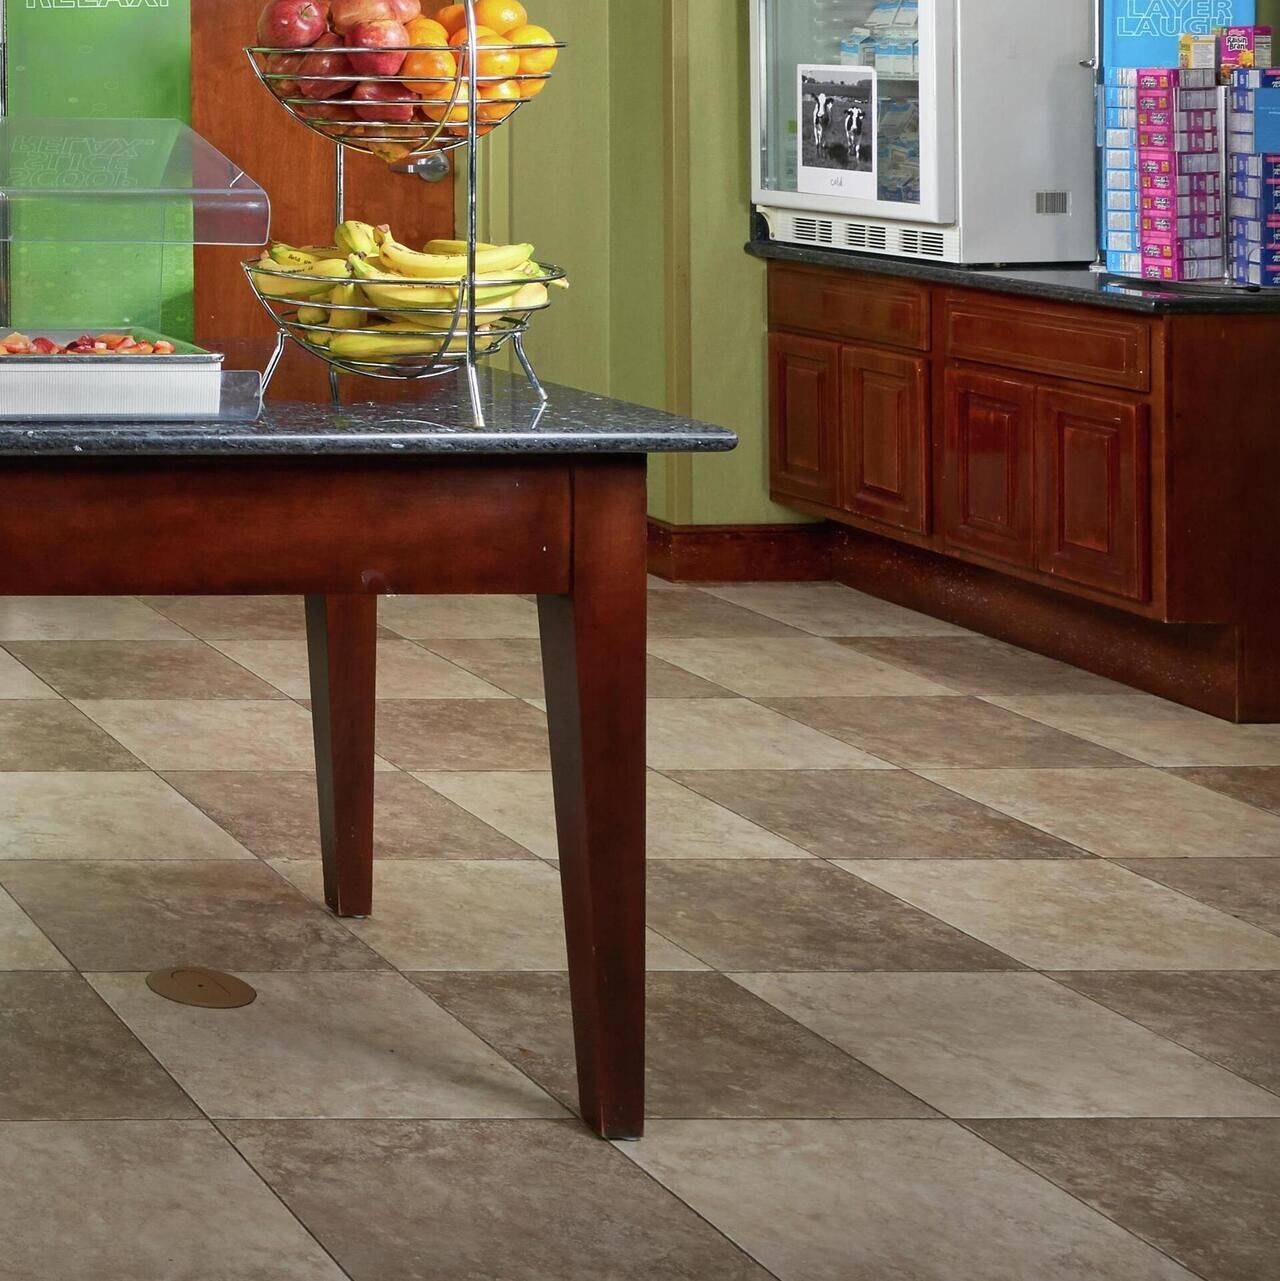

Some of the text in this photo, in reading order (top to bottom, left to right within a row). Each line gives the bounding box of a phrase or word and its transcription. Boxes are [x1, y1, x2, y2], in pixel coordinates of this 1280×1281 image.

[1127, 0, 1233, 18] LAYER
[1226, 36, 1248, 44] Raisin
[1229, 43, 1246, 51] Bran
